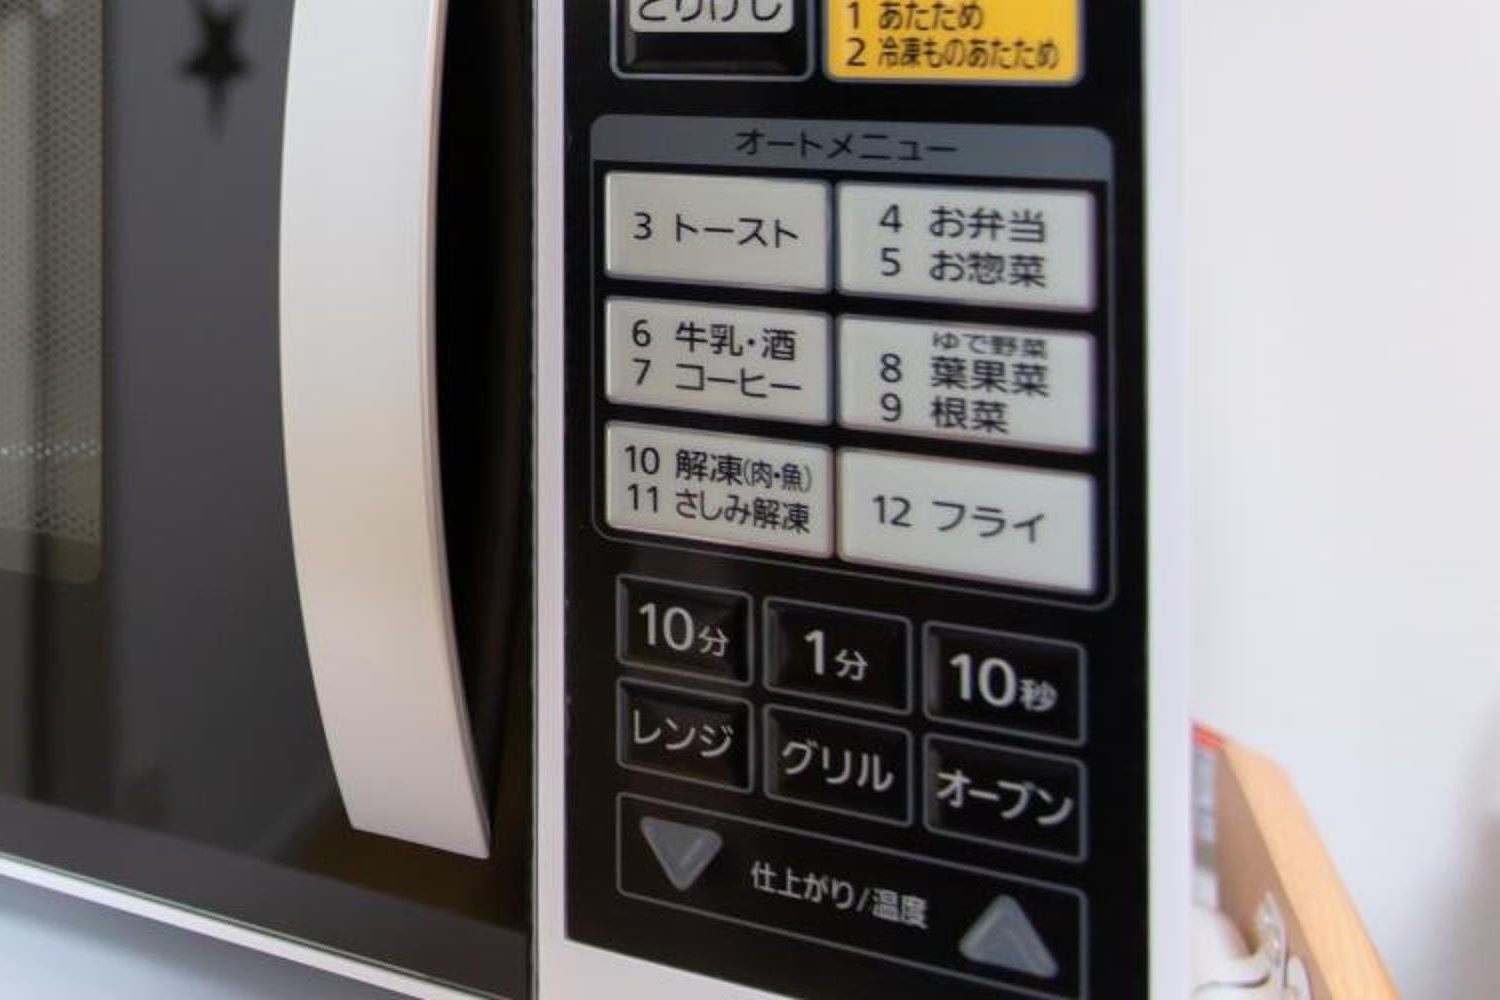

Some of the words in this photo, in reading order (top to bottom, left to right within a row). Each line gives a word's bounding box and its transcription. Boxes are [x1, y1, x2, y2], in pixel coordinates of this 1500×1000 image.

[847, 1, 861, 30] 1
[878, 0, 984, 32] あたため
[846, 37, 867, 67] 2
[877, 36, 1060, 71] 冷凍ものあたため
[735, 128, 959, 162] オートメニュー
[632, 212, 653, 241] 3
[674, 212, 799, 249] トースト
[879, 203, 902, 234] 4
[929, 205, 1046, 244] お弁当
[879, 247, 901, 278] 5
[929, 250, 1047, 289] お惣菜
[631, 319, 652, 348] 6
[932, 331, 1048, 360] ゆで野菜
[632, 358, 652, 387] 7
[675, 363, 803, 399] コーヒー
[879, 353, 902, 384] 8
[930, 355, 1050, 399] 葉果菜
[879, 391, 902, 423] 9
[930, 396, 1009, 436] 根菜
[624, 445, 660, 476] 10
[626, 484, 659, 514] 11
[674, 488, 810, 534] さしみ解凍
[873, 494, 913, 529] 12
[932, 499, 1046, 545] フライ
[638, 602, 731, 659] 10分
[803, 628, 870, 682] 1分
[949, 651, 1060, 713] 10秒
[632, 708, 735, 758] レンジ
[780, 739, 895, 794] グリル
[936, 768, 1074, 826] オープン
[750, 859, 930, 931] 仕上がり/温度
